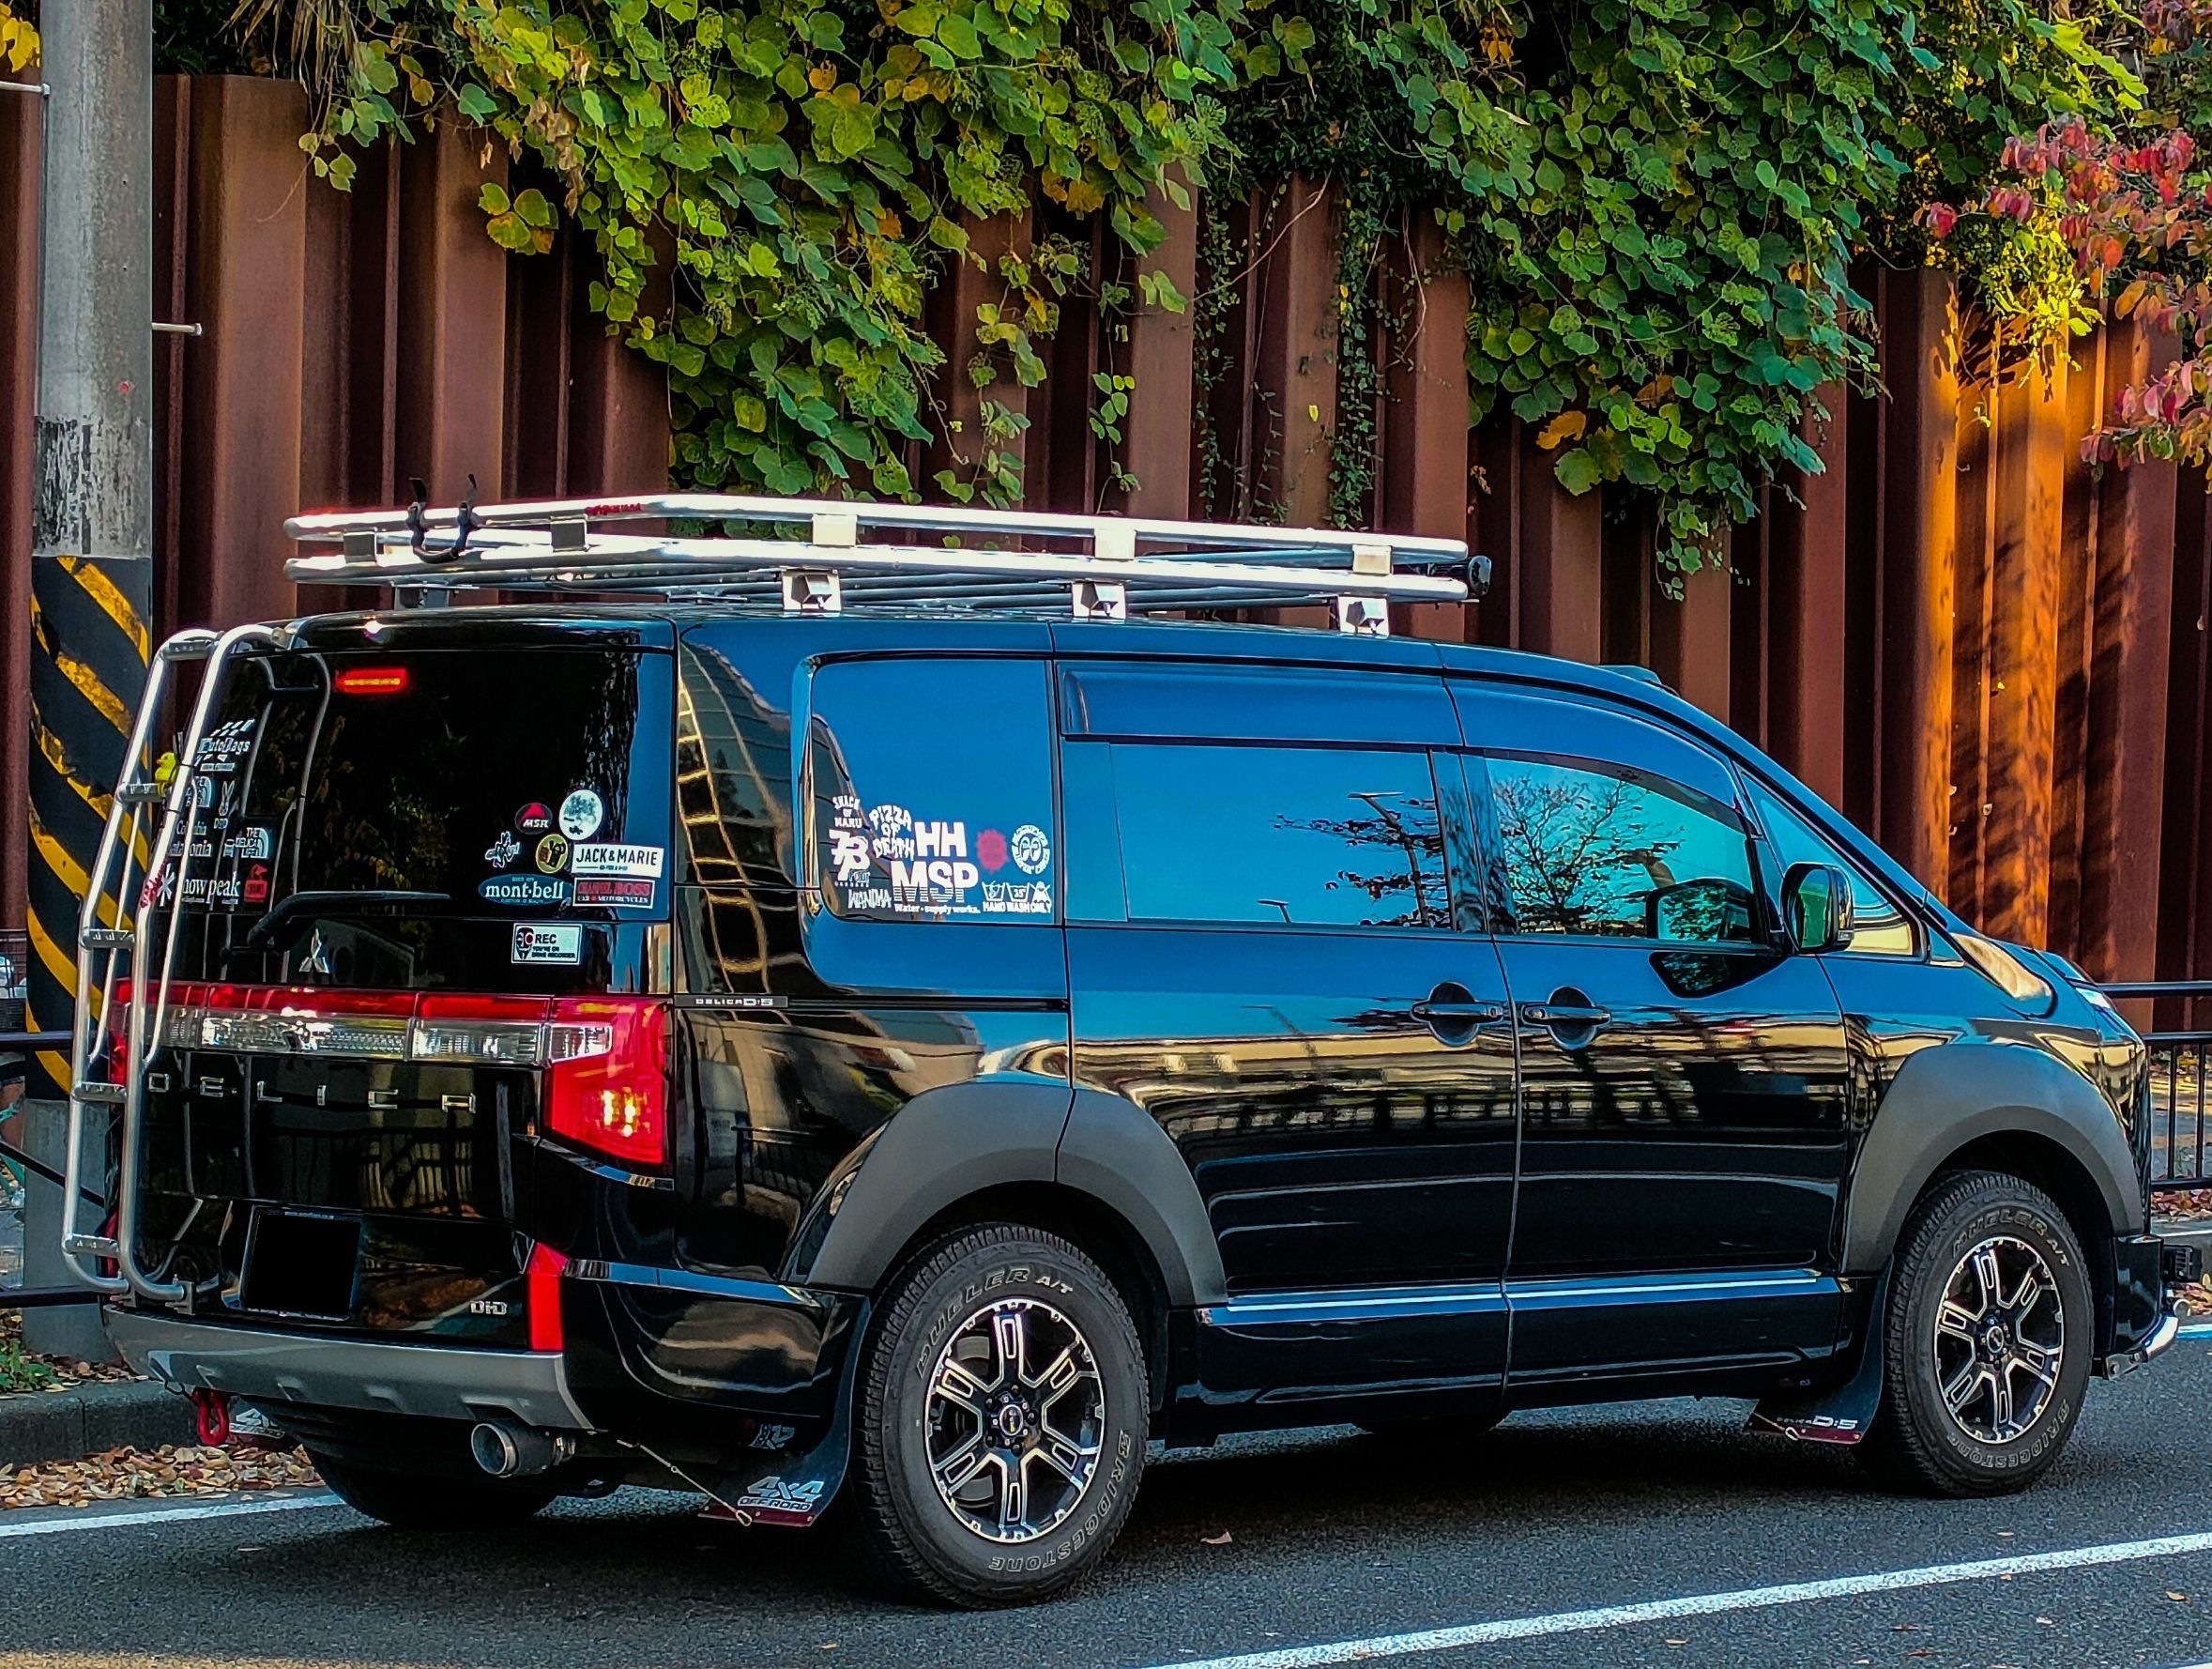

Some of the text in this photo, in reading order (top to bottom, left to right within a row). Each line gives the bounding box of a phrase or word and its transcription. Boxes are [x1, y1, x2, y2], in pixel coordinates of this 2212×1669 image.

[523, 819, 549, 828] MSR
[869, 805, 912, 832] PIZZA
[881, 822, 901, 839] OF
[873, 837, 915, 861] DEATH
[914, 821, 967, 857] HH
[183, 879, 208, 895] now
[206, 871, 240, 904] peak
[891, 861, 979, 902] MSP
[535, 934, 557, 944] REC
[916, 1267, 1074, 1380] DUELER A/T
[770, 1500, 812, 1511] ROAD
[987, 1429, 1131, 1572] BRIDGESTONE
